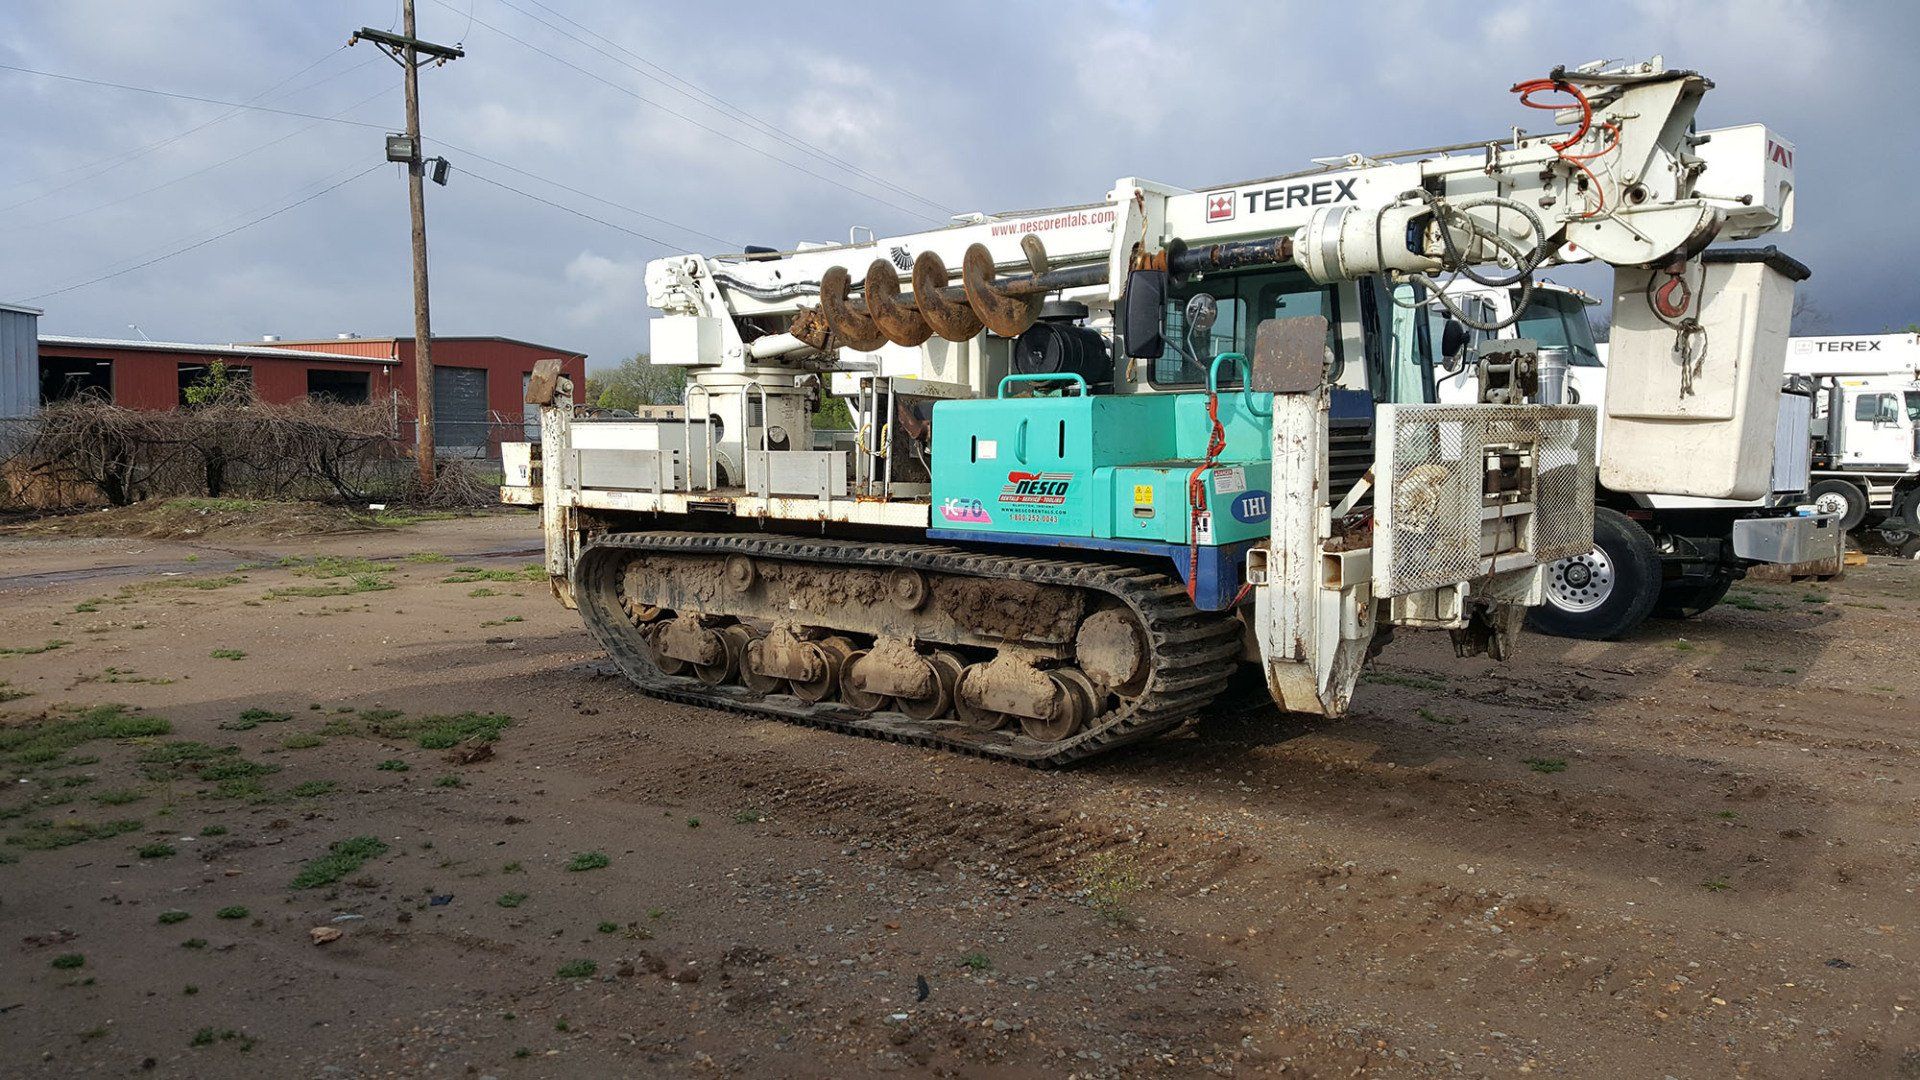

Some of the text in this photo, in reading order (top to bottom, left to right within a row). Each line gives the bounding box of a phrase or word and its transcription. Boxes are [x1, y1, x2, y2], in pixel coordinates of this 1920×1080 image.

[1243, 177, 1358, 213] TEREX
[991, 210, 1115, 236] www.nescorentals.com
[1815, 340, 1881, 352] TEREX
[1015, 480, 1069, 495] NESCO
[1242, 497, 1266, 517] IHI
